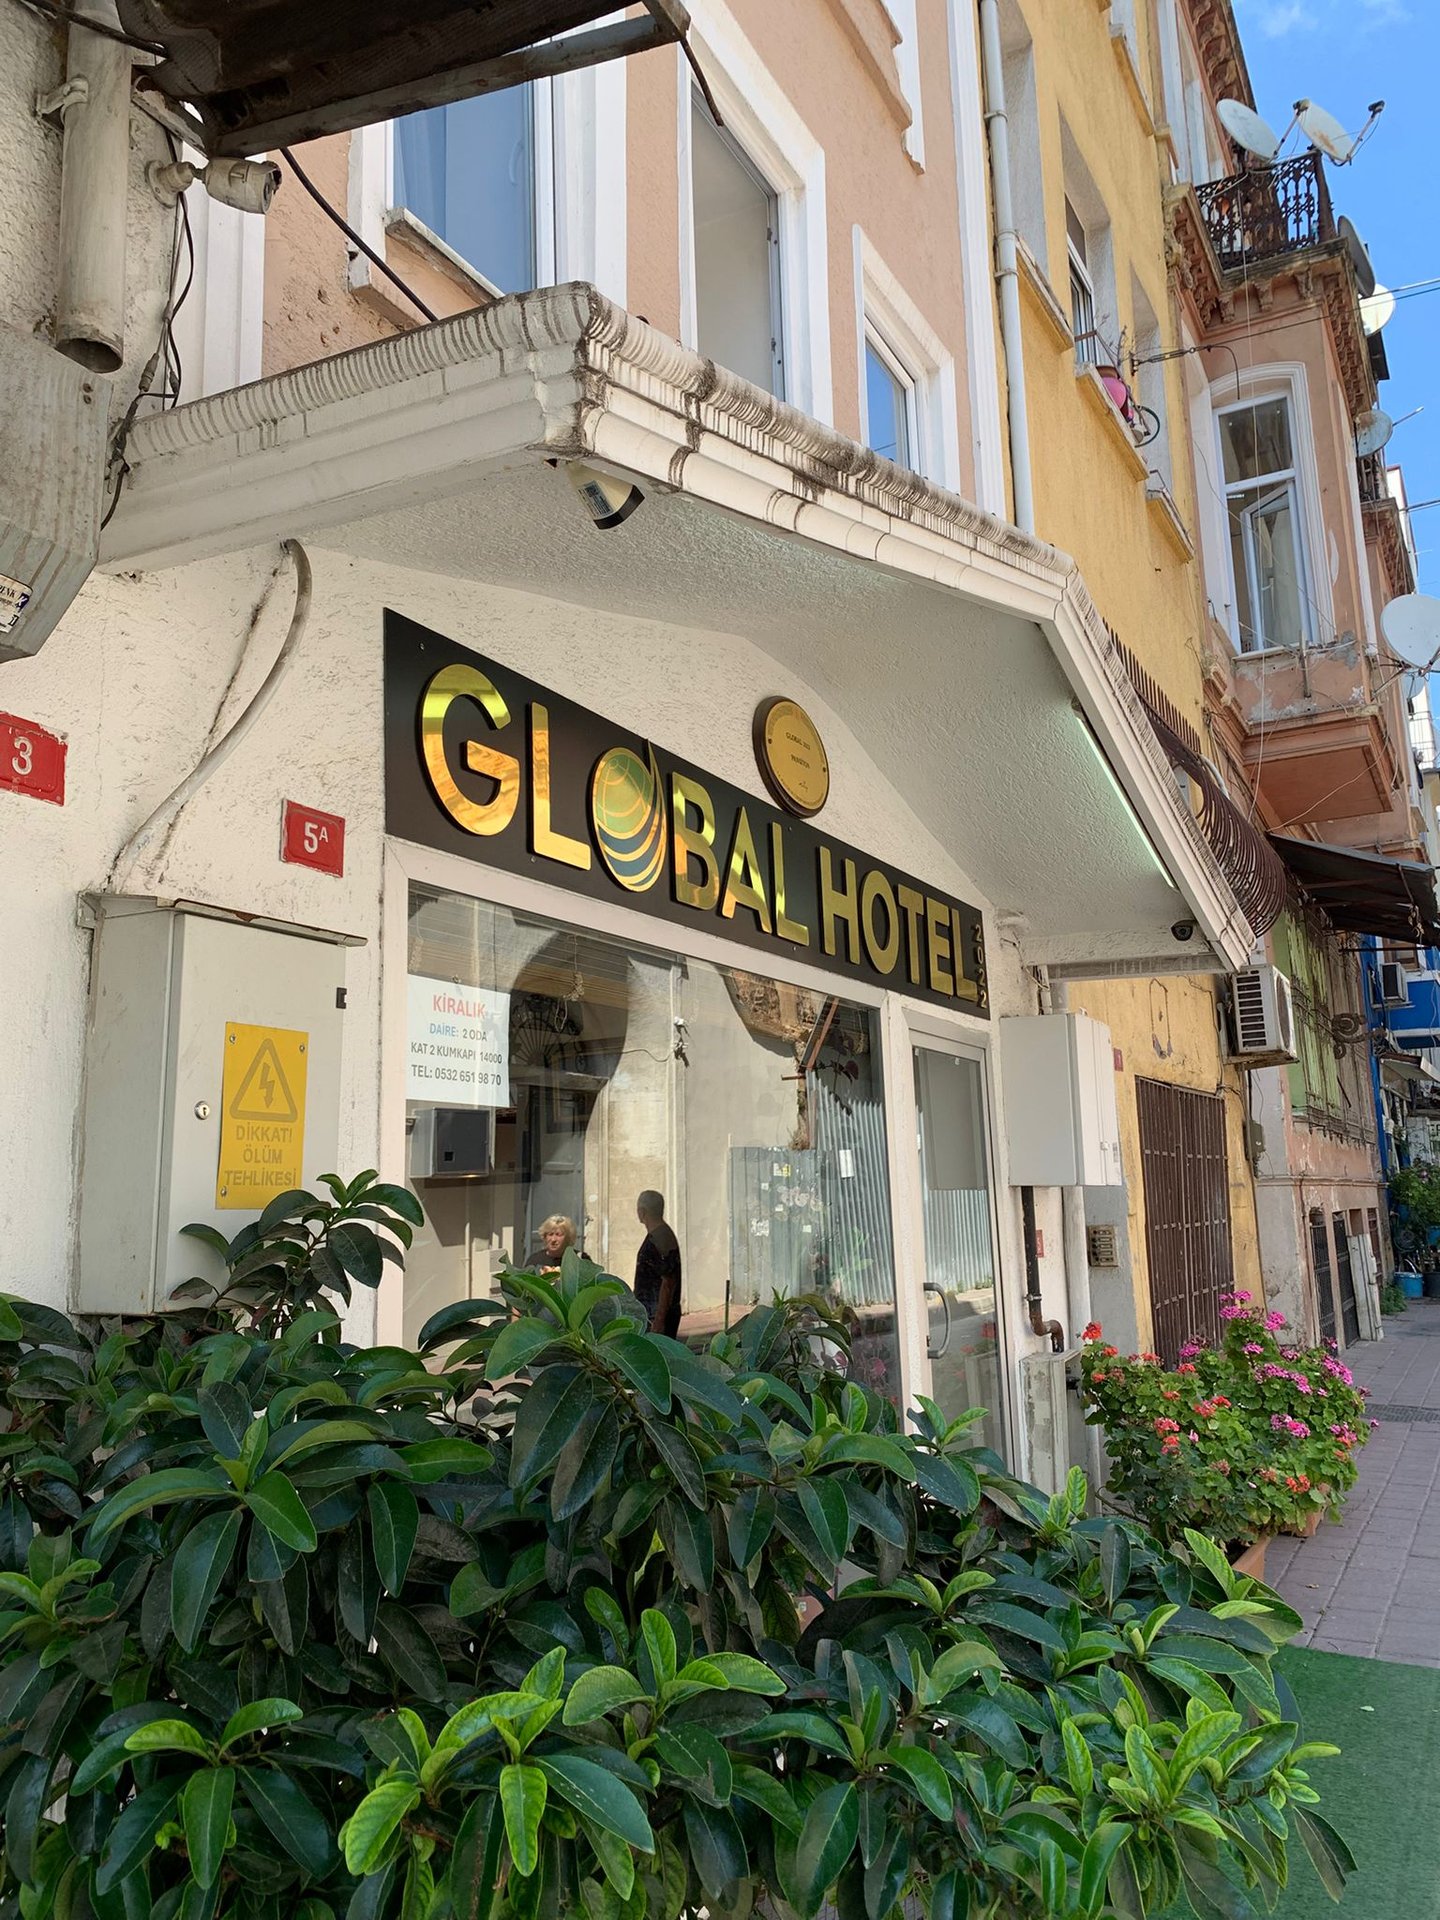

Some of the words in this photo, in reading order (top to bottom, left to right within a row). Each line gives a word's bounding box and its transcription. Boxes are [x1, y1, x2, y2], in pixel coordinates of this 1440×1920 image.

[12, 736, 33, 775] 3
[304, 822, 329, 854] 5A
[420, 663, 810, 946] GLOBAL
[819, 846, 977, 1002] HOTEL
[975, 924, 988, 1008] 2022
[432, 993, 486, 1019] KİRALIK
[429, 1023, 459, 1037] DAİRE:
[410, 1042, 428, 1055] KAT
[430, 1045, 435, 1056] 2
[436, 1047, 476, 1061] KUMKAPI
[480, 1051, 503, 1064] 14000
[411, 1064, 433, 1079] TEL:
[434, 1067, 457, 1081] 0532
[459, 1071, 476, 1084] 651
[478, 1072, 489, 1085] 98
[490, 1073, 502, 1086] 70
[235, 1121, 294, 1143] DİKKAT!
[242, 1144, 283, 1164] ÖLÜM
[223, 1168, 297, 1187] TEHLİKESİ
